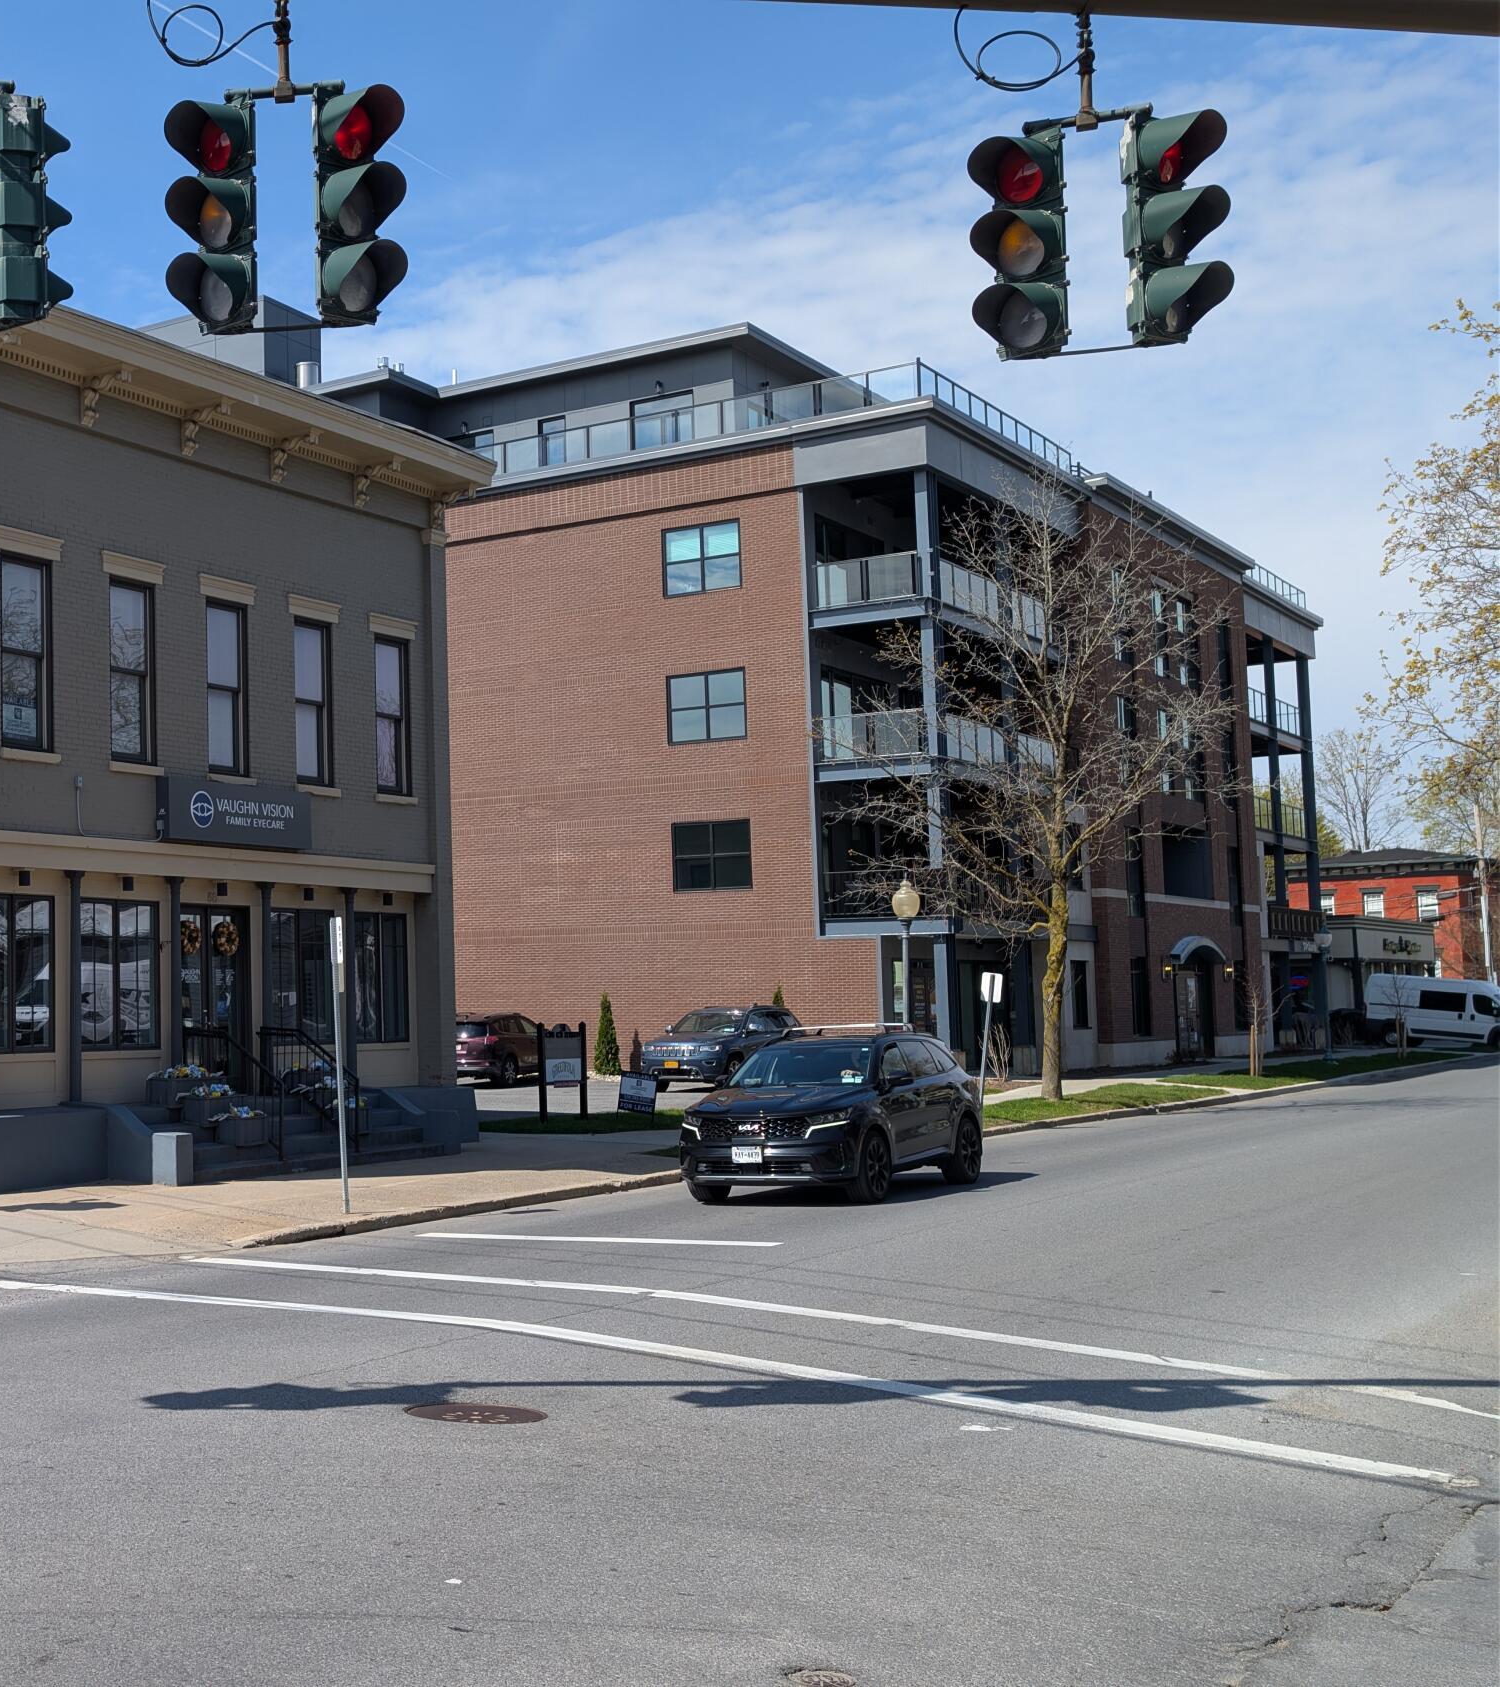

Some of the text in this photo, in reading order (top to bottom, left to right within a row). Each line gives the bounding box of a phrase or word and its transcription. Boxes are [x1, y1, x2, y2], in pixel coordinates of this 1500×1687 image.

[216, 798, 294, 818] VAUGHN VISION
[225, 815, 285, 830] FAMILY EYECARE
[633, 1104, 653, 1112] LEASE
